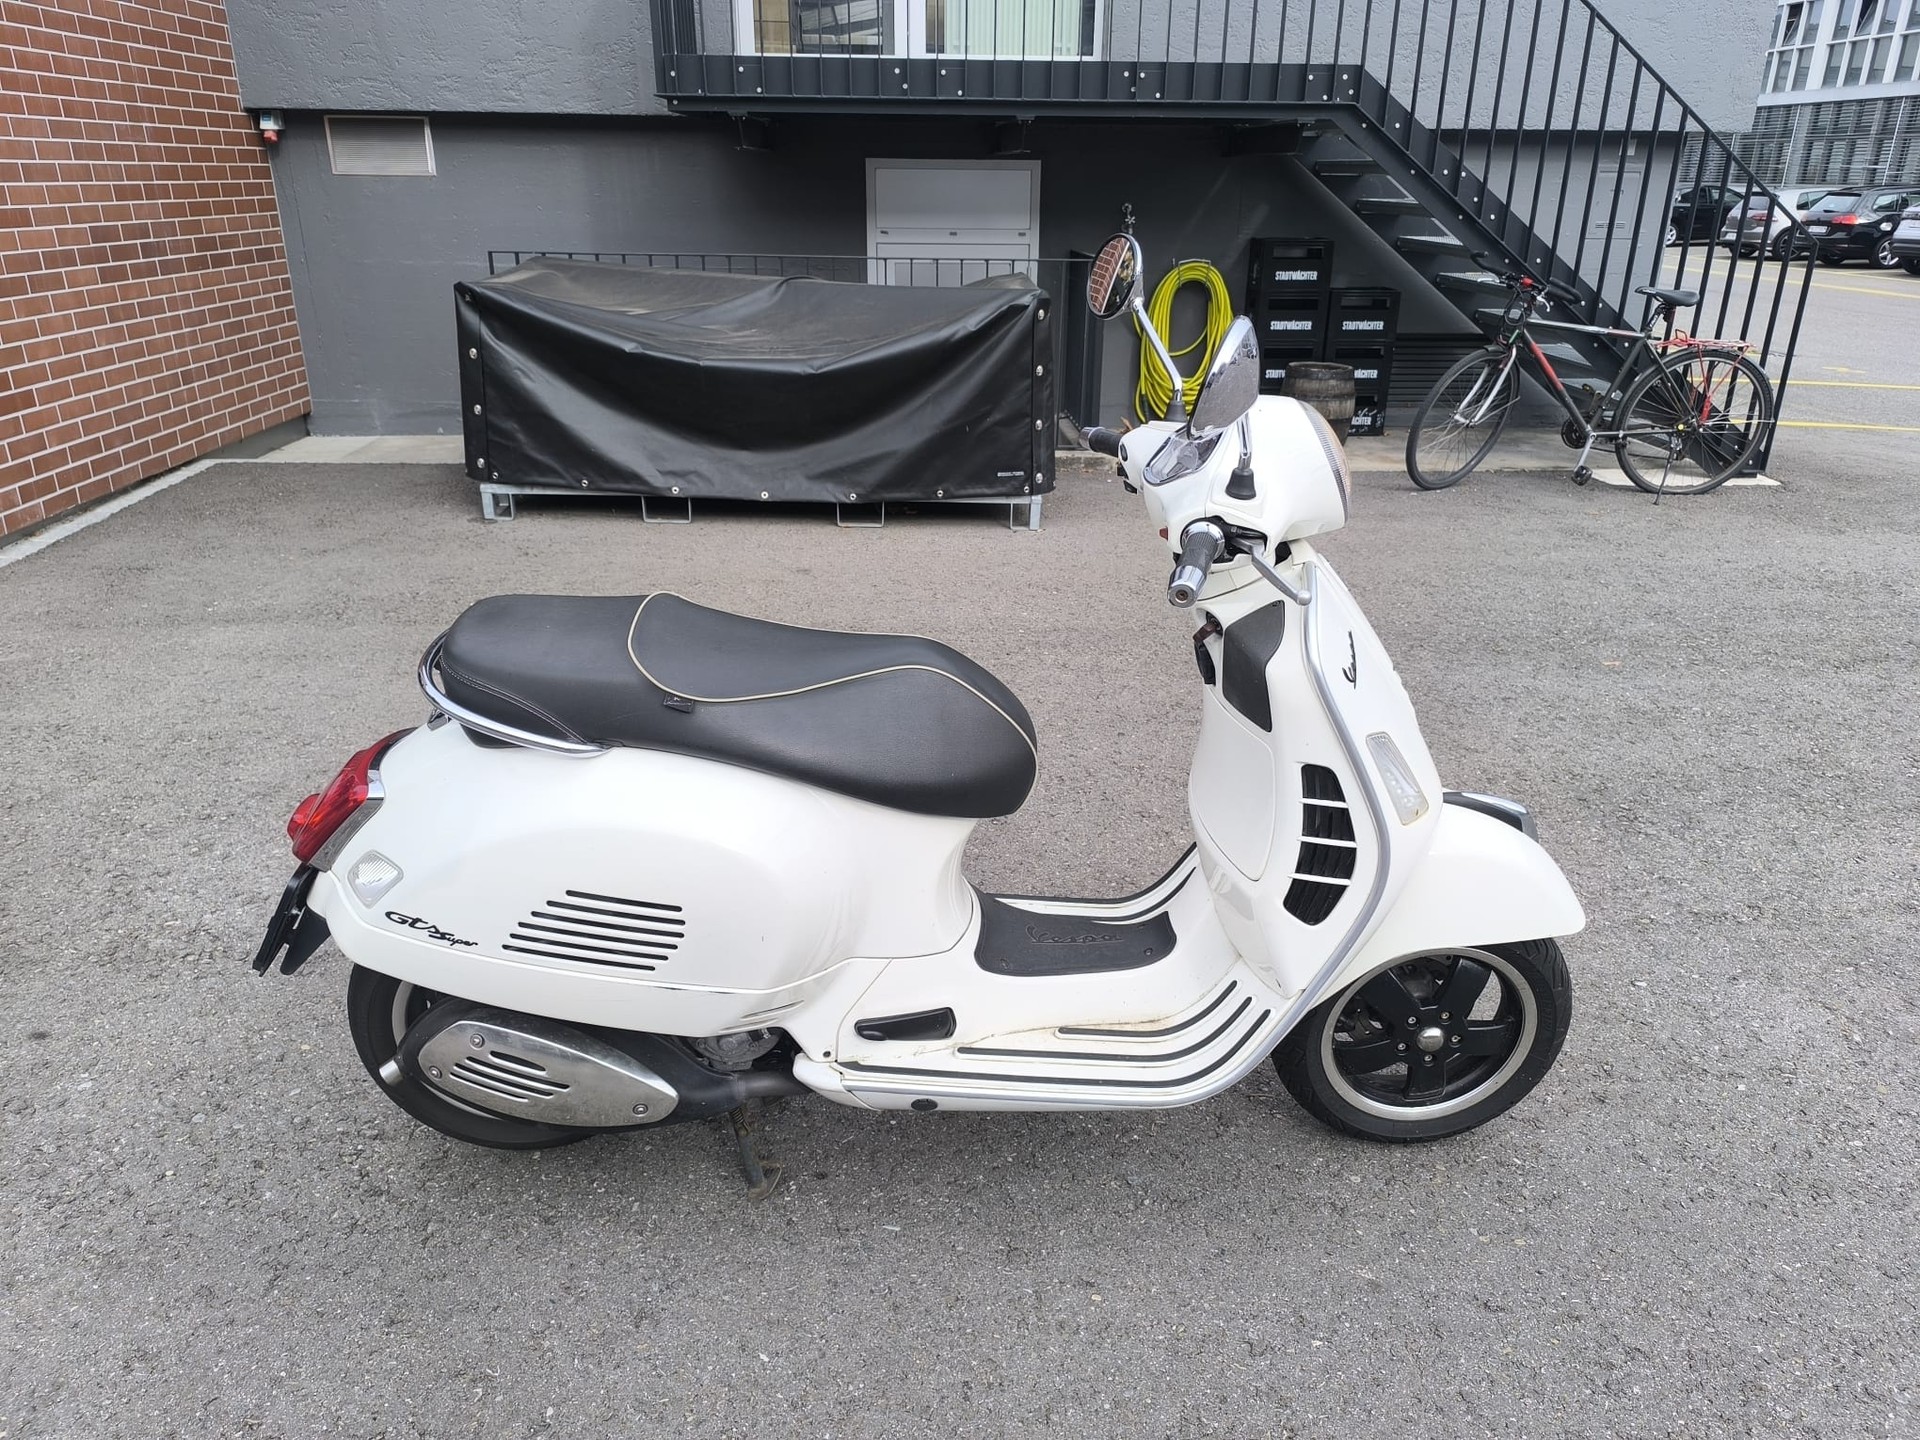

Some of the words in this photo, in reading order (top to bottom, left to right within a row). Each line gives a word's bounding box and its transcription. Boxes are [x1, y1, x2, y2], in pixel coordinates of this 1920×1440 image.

[1275, 269, 1318, 281] STADTWÄCHTER
[1270, 319, 1312, 331] STADTWÄCHTER
[1342, 319, 1384, 331] STADTWÄCHTER
[1354, 368, 1378, 379] WÄCHTER
[1025, 923, 1125, 946] Vespa
